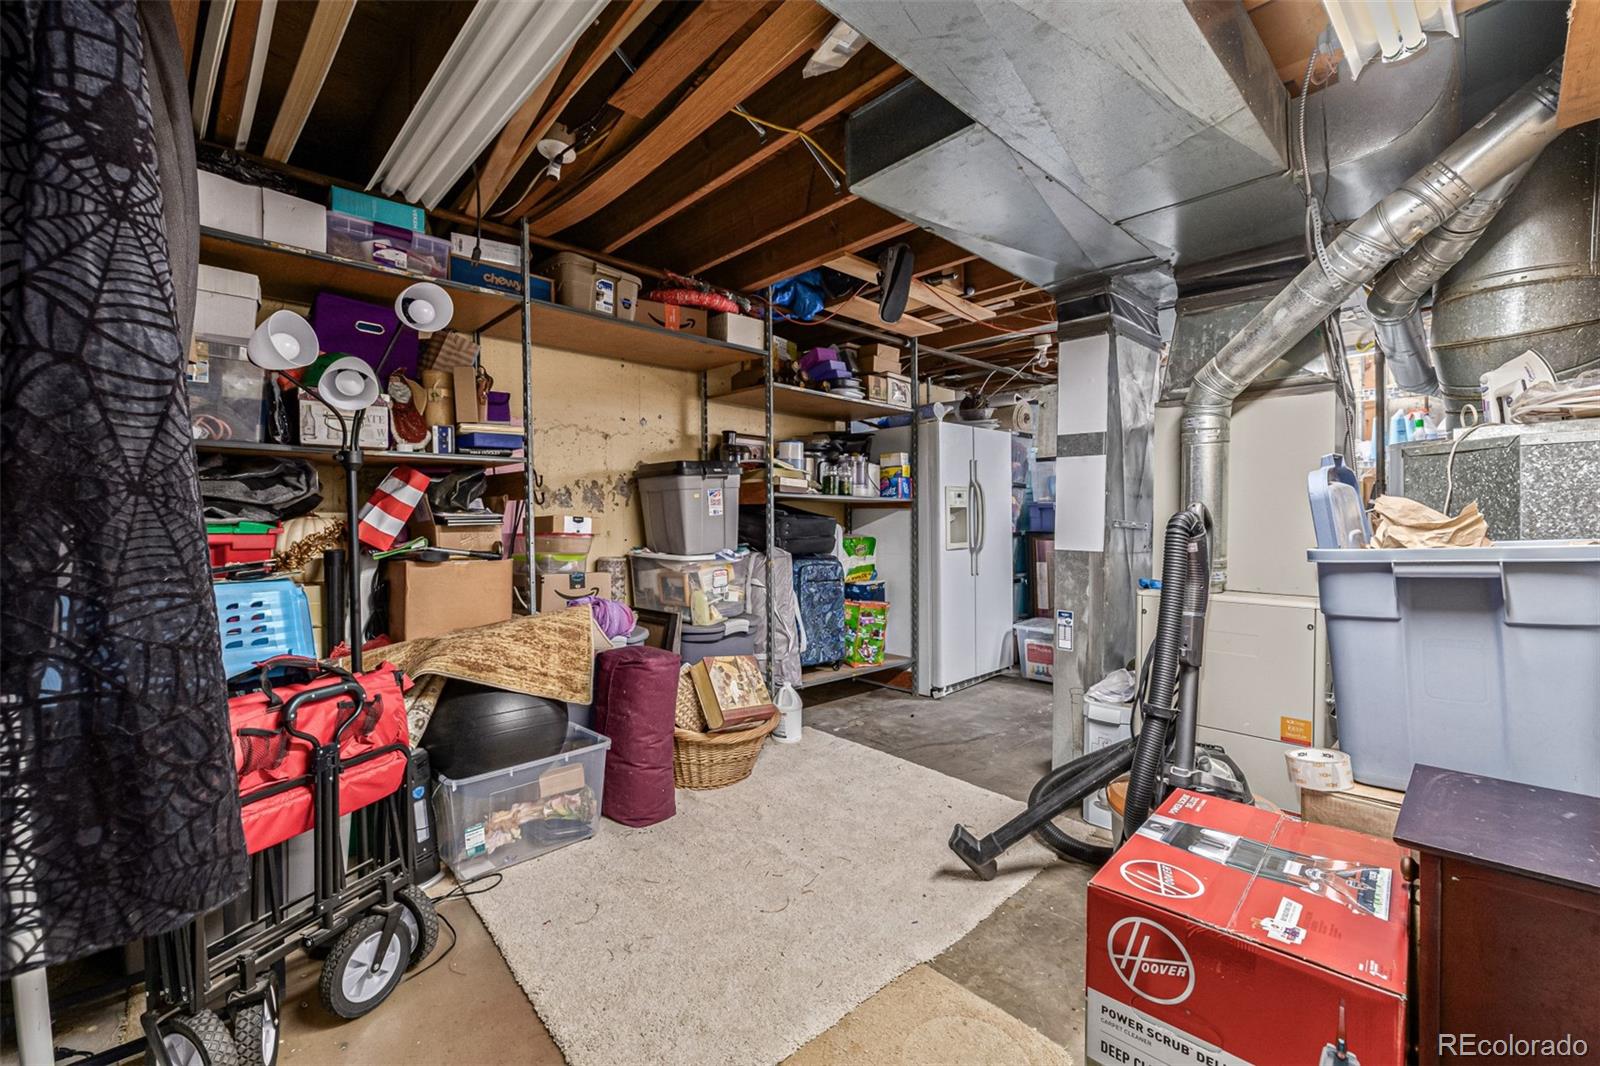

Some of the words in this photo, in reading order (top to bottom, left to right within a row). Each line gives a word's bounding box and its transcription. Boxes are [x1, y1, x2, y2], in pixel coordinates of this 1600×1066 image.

[483, 272, 522, 292] chewy
[1113, 921, 1189, 985] HOOVER
[1101, 1004, 1144, 1034] POWER
[1101, 1018, 1123, 1032] CARPET
[1124, 1029, 1152, 1046] CLEANER
[1100, 1040, 1130, 1064] DEEP
